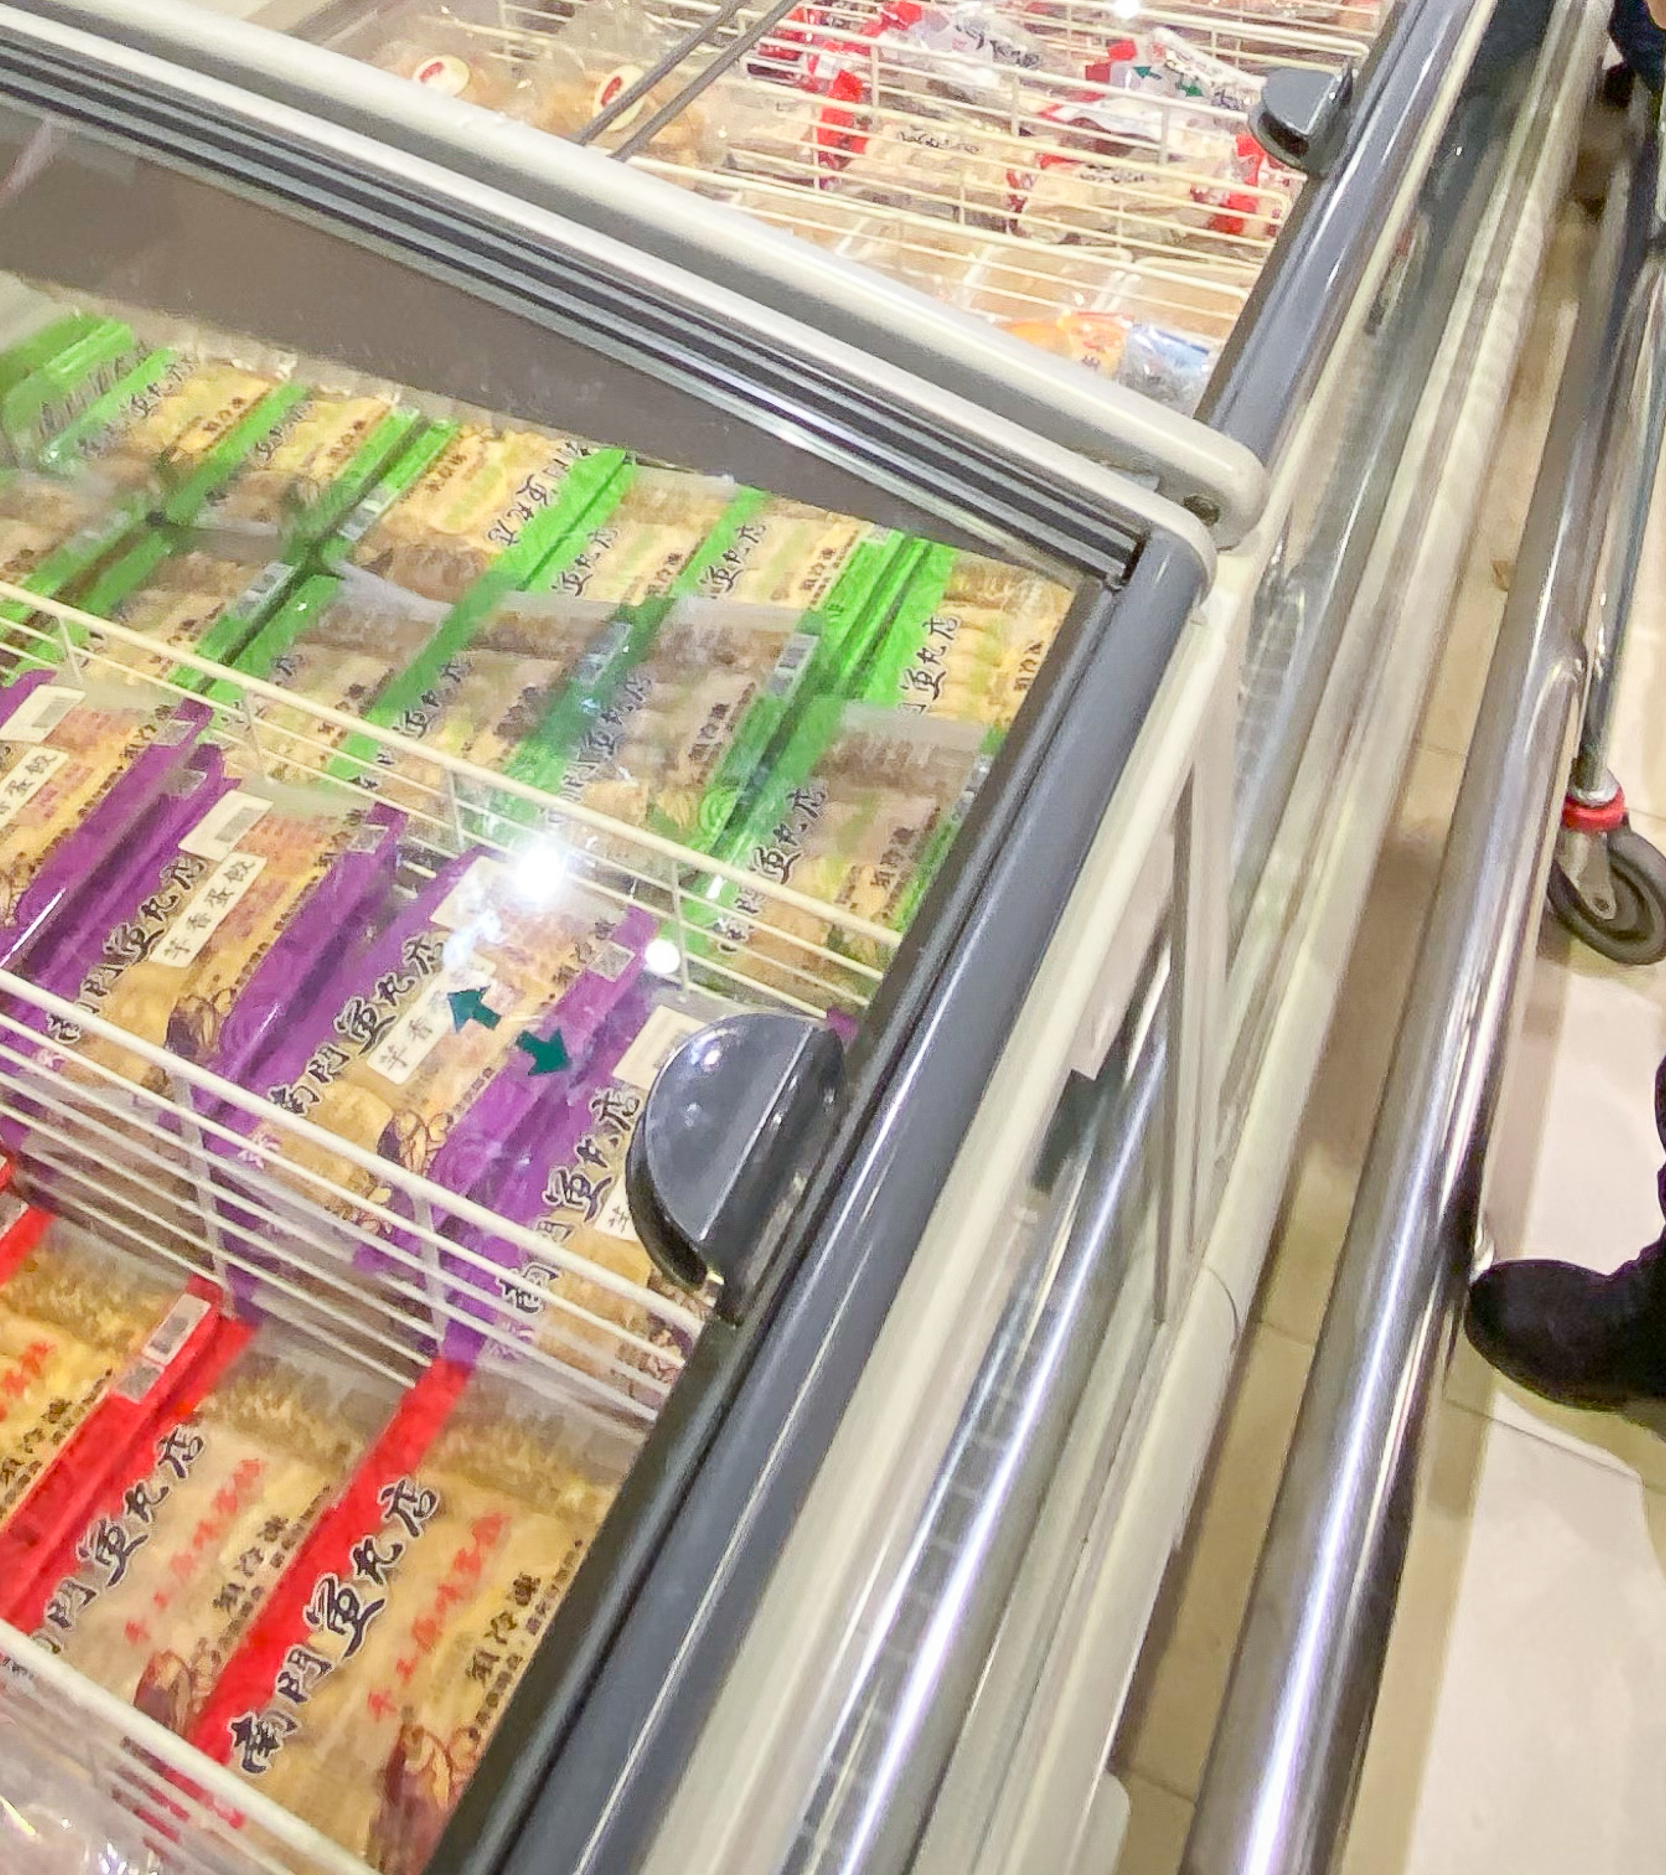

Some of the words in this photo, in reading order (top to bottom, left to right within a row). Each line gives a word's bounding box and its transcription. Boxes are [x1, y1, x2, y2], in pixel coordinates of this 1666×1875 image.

[162, 857, 254, 954] 芋香蛋餃
[228, 1474, 440, 1775] 南門魚丸店
